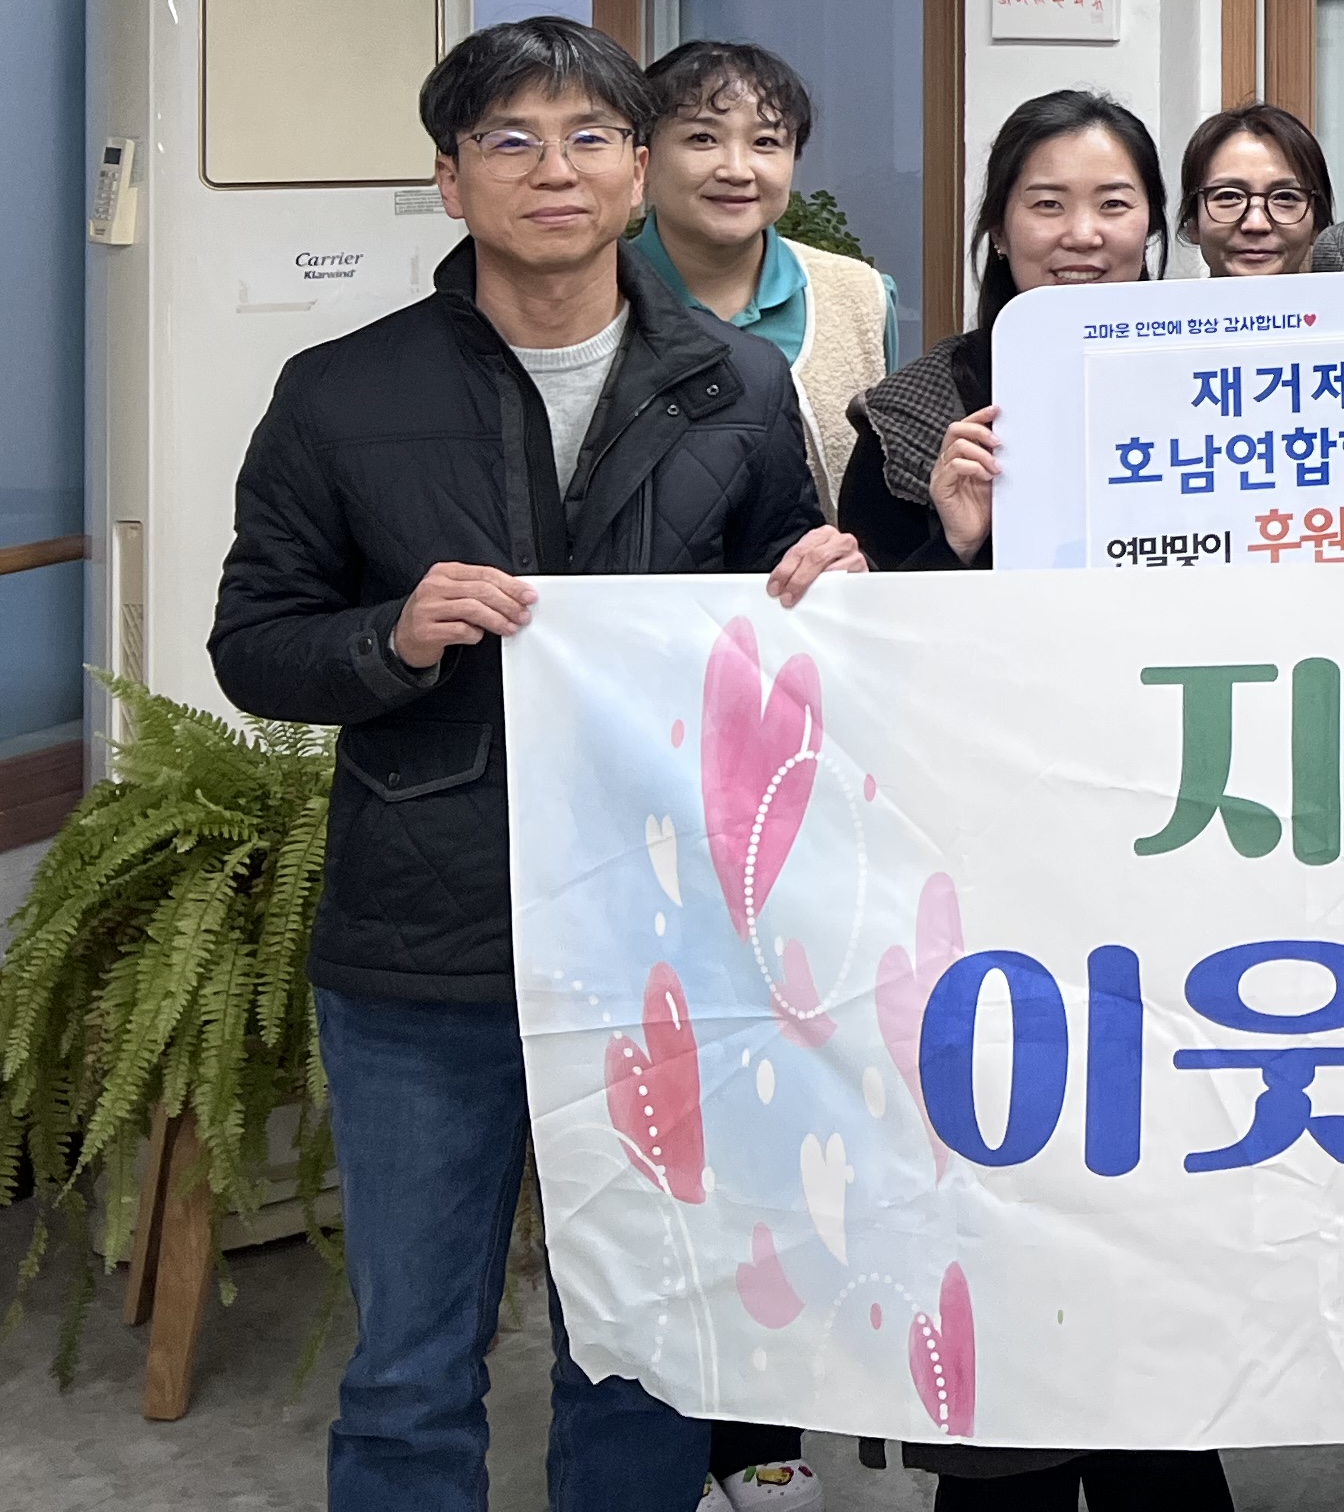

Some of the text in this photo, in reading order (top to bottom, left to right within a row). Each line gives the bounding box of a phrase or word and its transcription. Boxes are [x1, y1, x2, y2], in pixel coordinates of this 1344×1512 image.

[296, 252, 363, 267] Carrier
[1083, 314, 1302, 339] 고마운 인연에 항상 감사합니다
